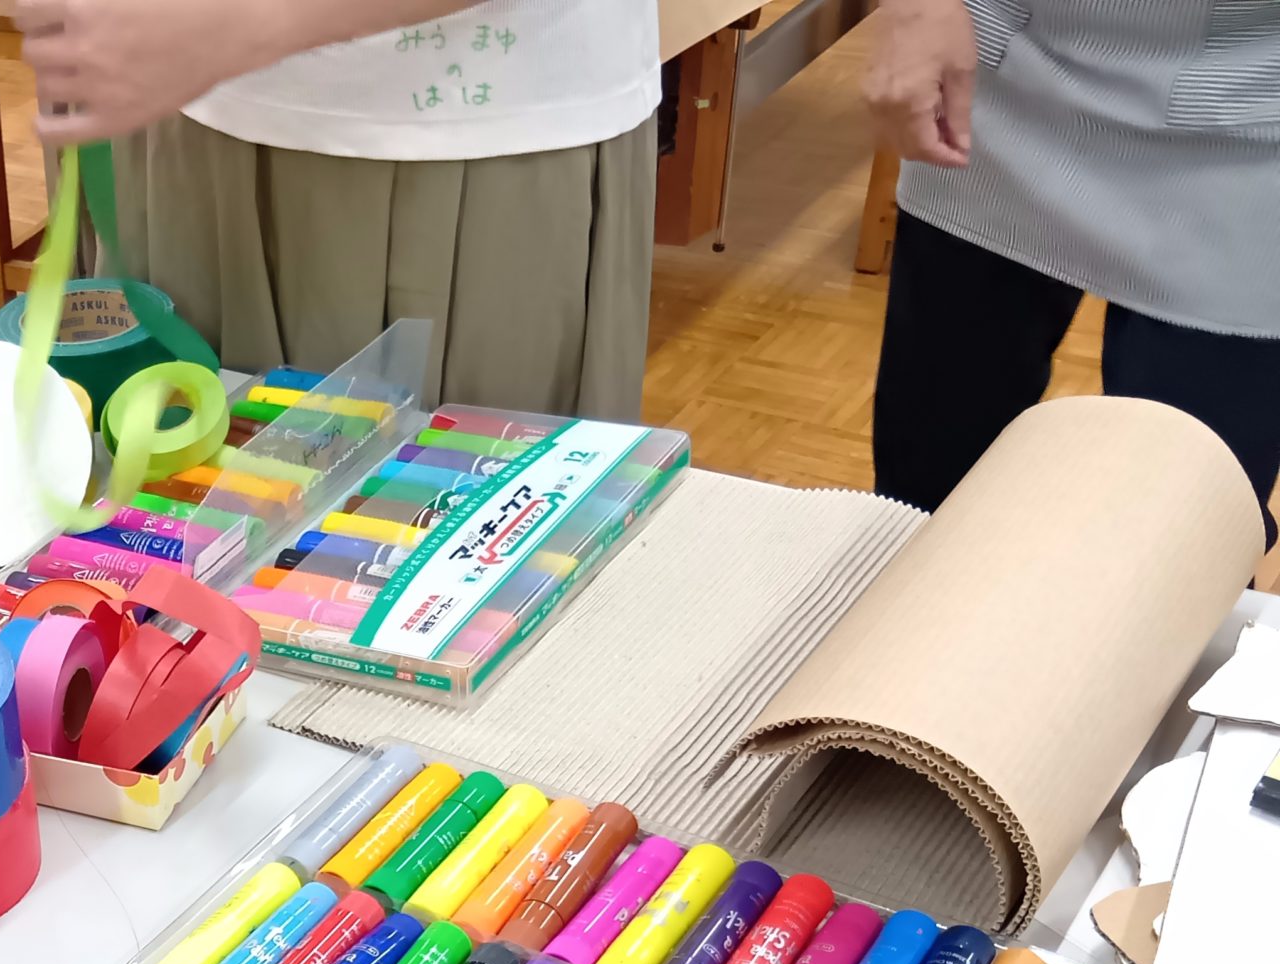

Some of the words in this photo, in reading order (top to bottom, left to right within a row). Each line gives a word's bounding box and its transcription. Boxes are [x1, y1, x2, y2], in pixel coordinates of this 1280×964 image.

[71, 300, 109, 312] ASKUL
[96, 315, 130, 328] ASKUL
[564, 450, 590, 463] 12
[448, 485, 532, 560] マッキーケア
[400, 594, 441, 631] ZEBRA
[364, 664, 376, 674] 12
